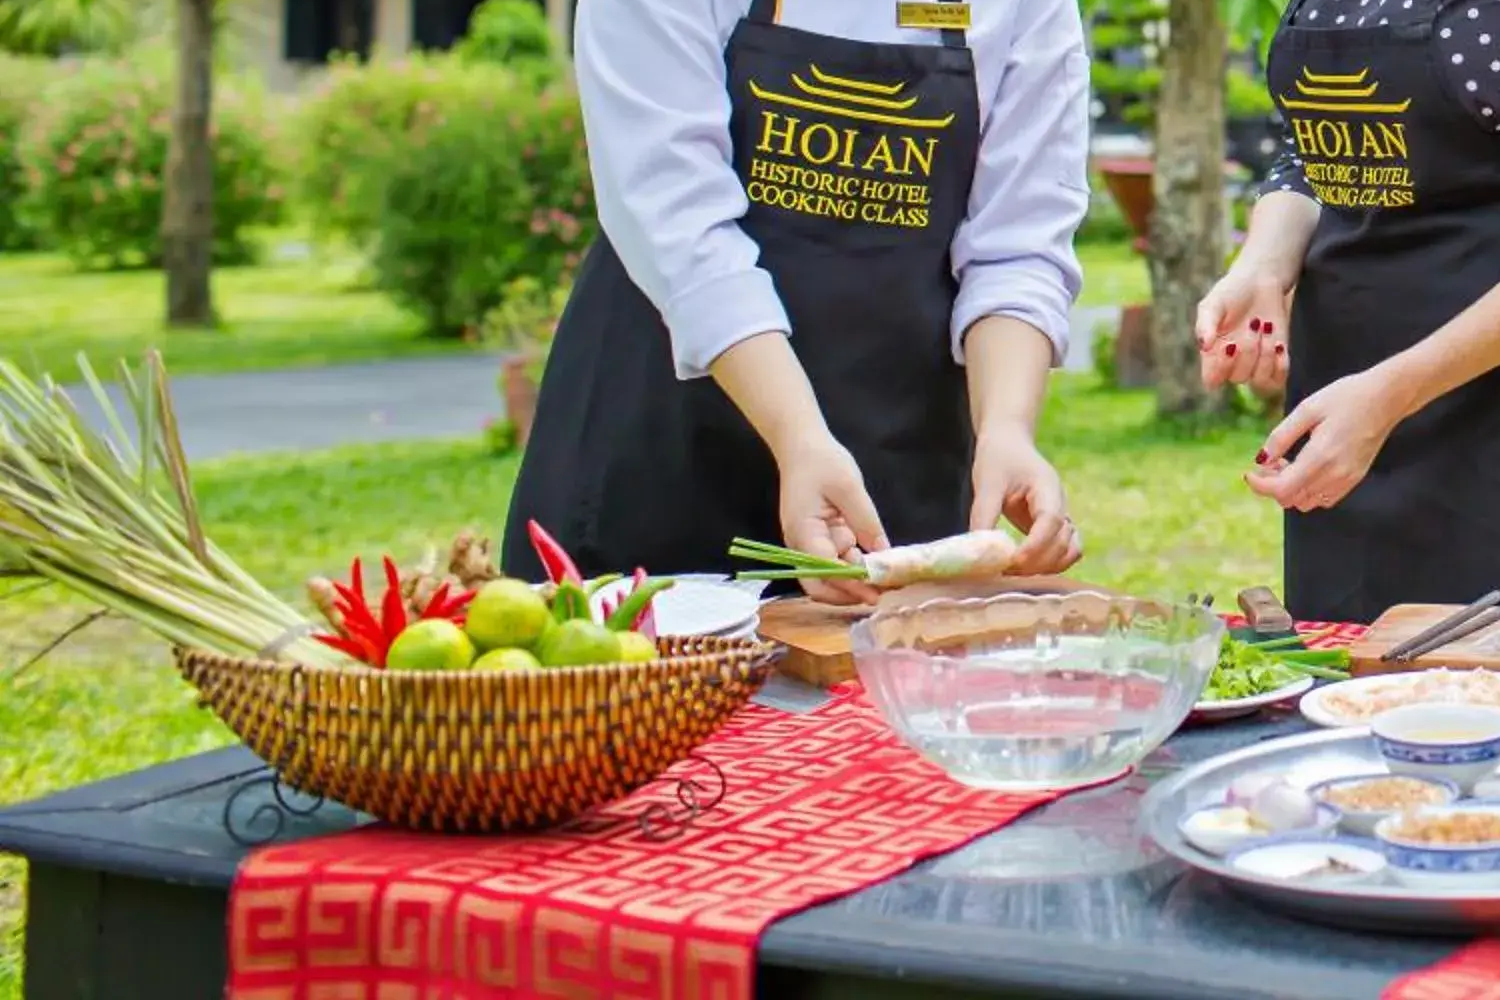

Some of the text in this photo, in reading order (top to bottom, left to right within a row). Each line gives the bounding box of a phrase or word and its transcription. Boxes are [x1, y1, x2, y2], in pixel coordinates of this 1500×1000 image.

[751, 159, 932, 205] HISTORIC HOTEL
[1362, 166, 1416, 187] HOTEL
[747, 181, 929, 227] COOKING CLASS
[1359, 187, 1416, 208] CLASS
